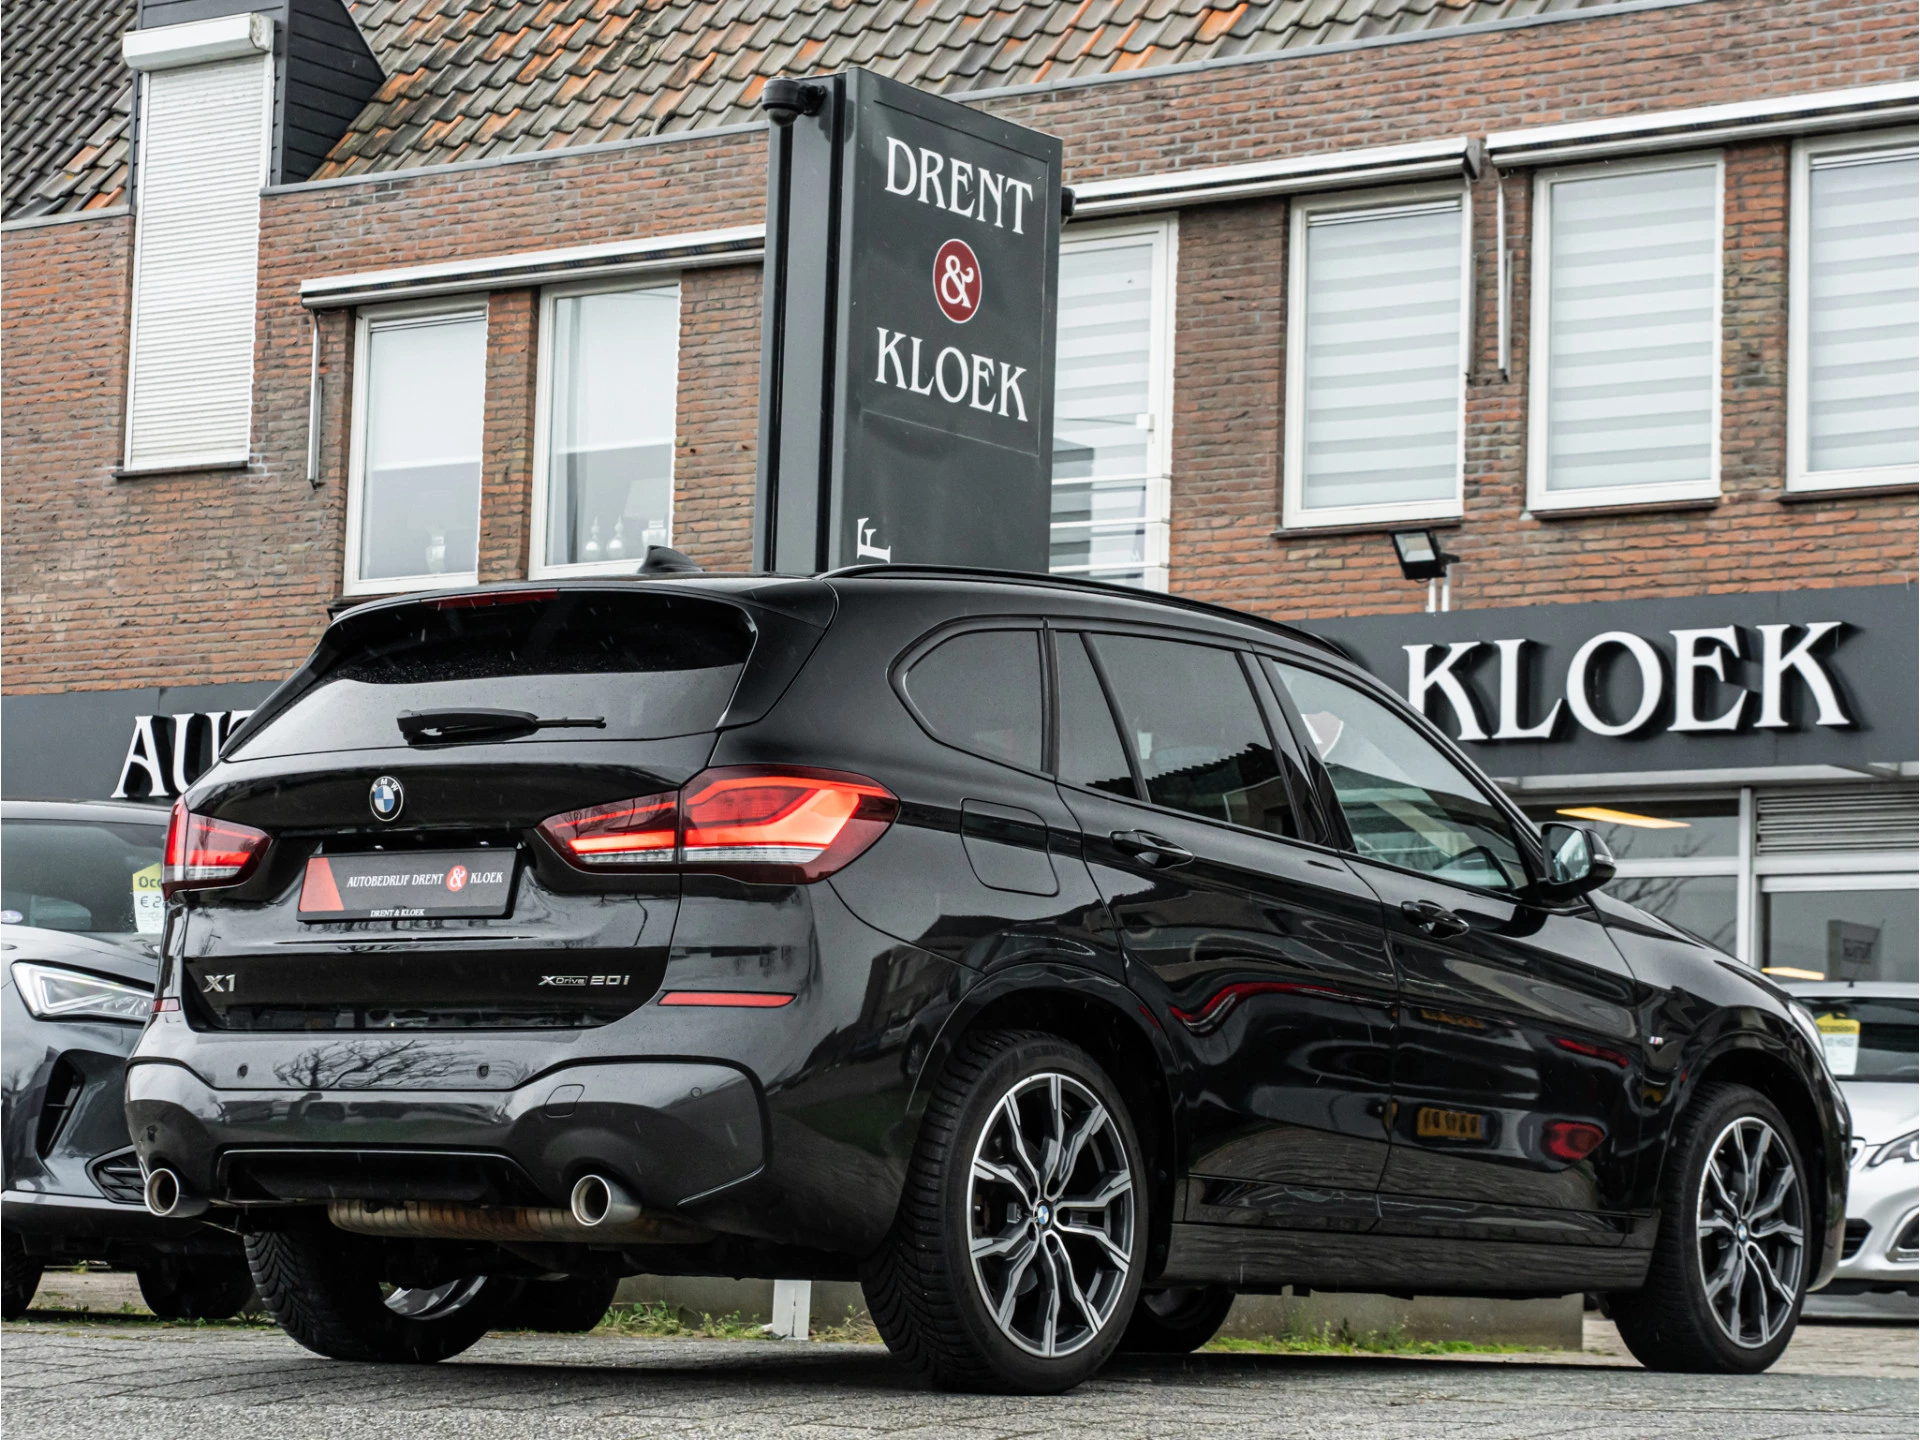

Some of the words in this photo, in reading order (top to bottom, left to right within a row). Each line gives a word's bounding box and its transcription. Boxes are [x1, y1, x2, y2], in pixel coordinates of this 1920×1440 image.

[884, 136, 1033, 235] DRENT
[940, 254, 974, 308] &
[875, 327, 1029, 423] KLOEK
[1402, 621, 1850, 741] KLOEK
[346, 874, 410, 888] AUTOBEDRIJF
[411, 873, 444, 886] DRENT
[450, 868, 465, 888] &
[470, 871, 504, 884] KLOEK
[370, 910, 394, 918] DRENT
[394, 909, 400, 917] &
[401, 908, 425, 917] KLOEK
[202, 974, 236, 993] X1
